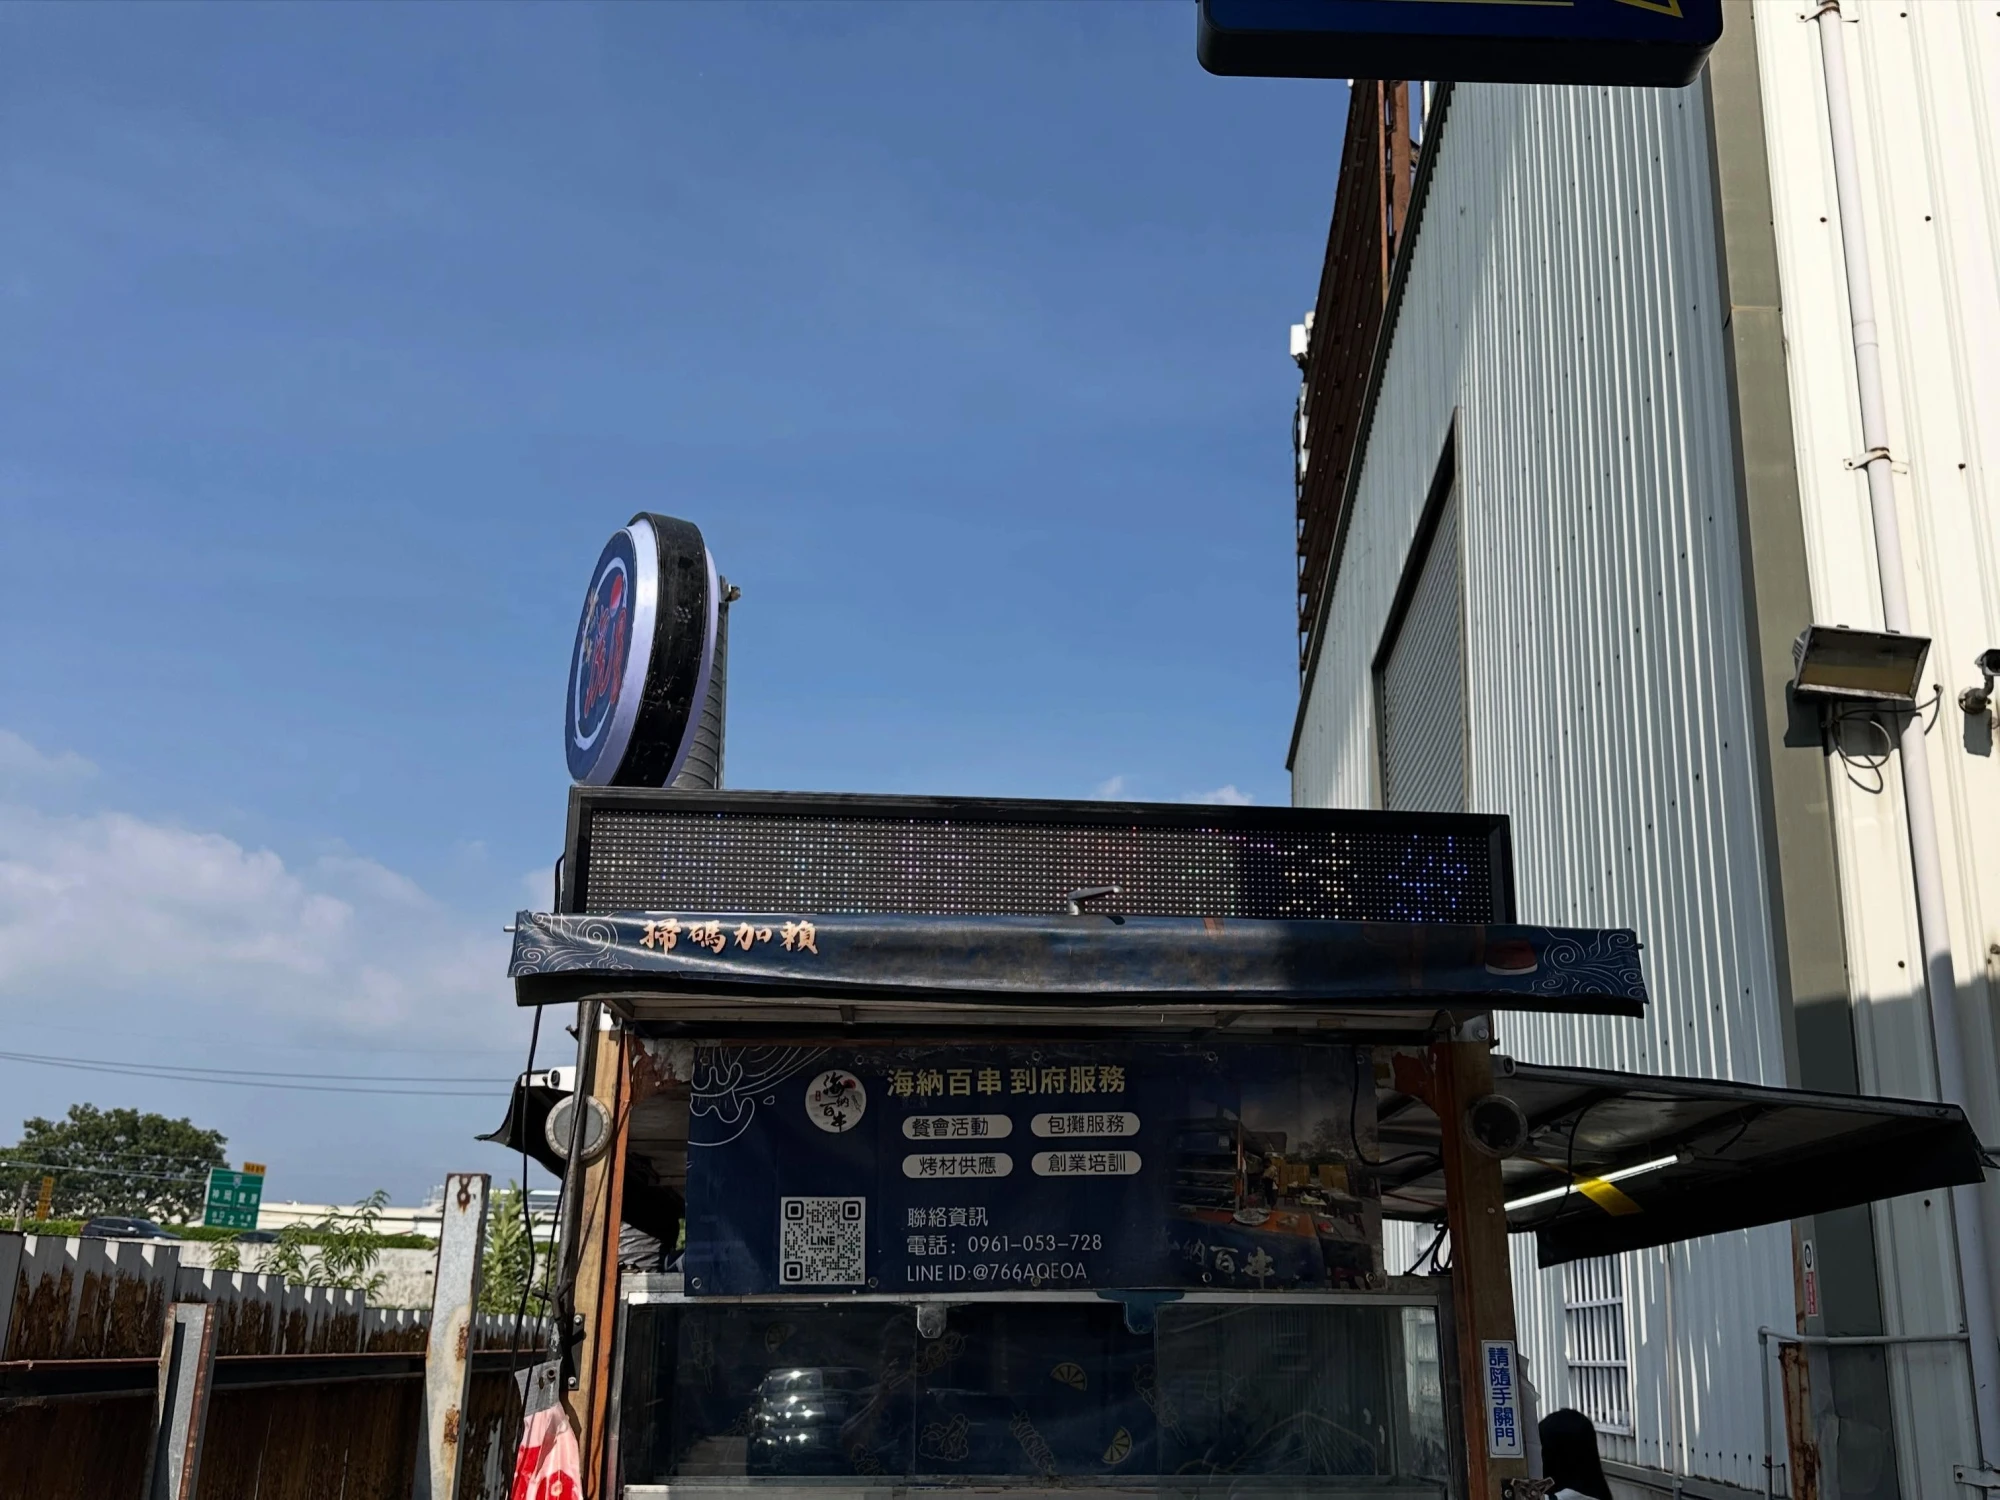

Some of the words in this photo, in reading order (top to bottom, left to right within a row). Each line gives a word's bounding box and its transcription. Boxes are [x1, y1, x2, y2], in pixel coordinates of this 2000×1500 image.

[887, 1067, 1003, 1097] 海納百串
[1010, 1065, 1126, 1095] 到府服務
[912, 1117, 989, 1137] 餐會活動
[1047, 1115, 1125, 1134] 包攤服務
[919, 1155, 997, 1175] 烤材供應
[1048, 1153, 1126, 1173] 創業培訓
[907, 1207, 988, 1228] 聯絡資訊
[810, 1236, 835, 1246] LINE
[968, 1234, 1102, 1252] 0961-053-728
[907, 1265, 943, 1282] LINE
[1488, 1347, 1515, 1447] 請隨手關門
